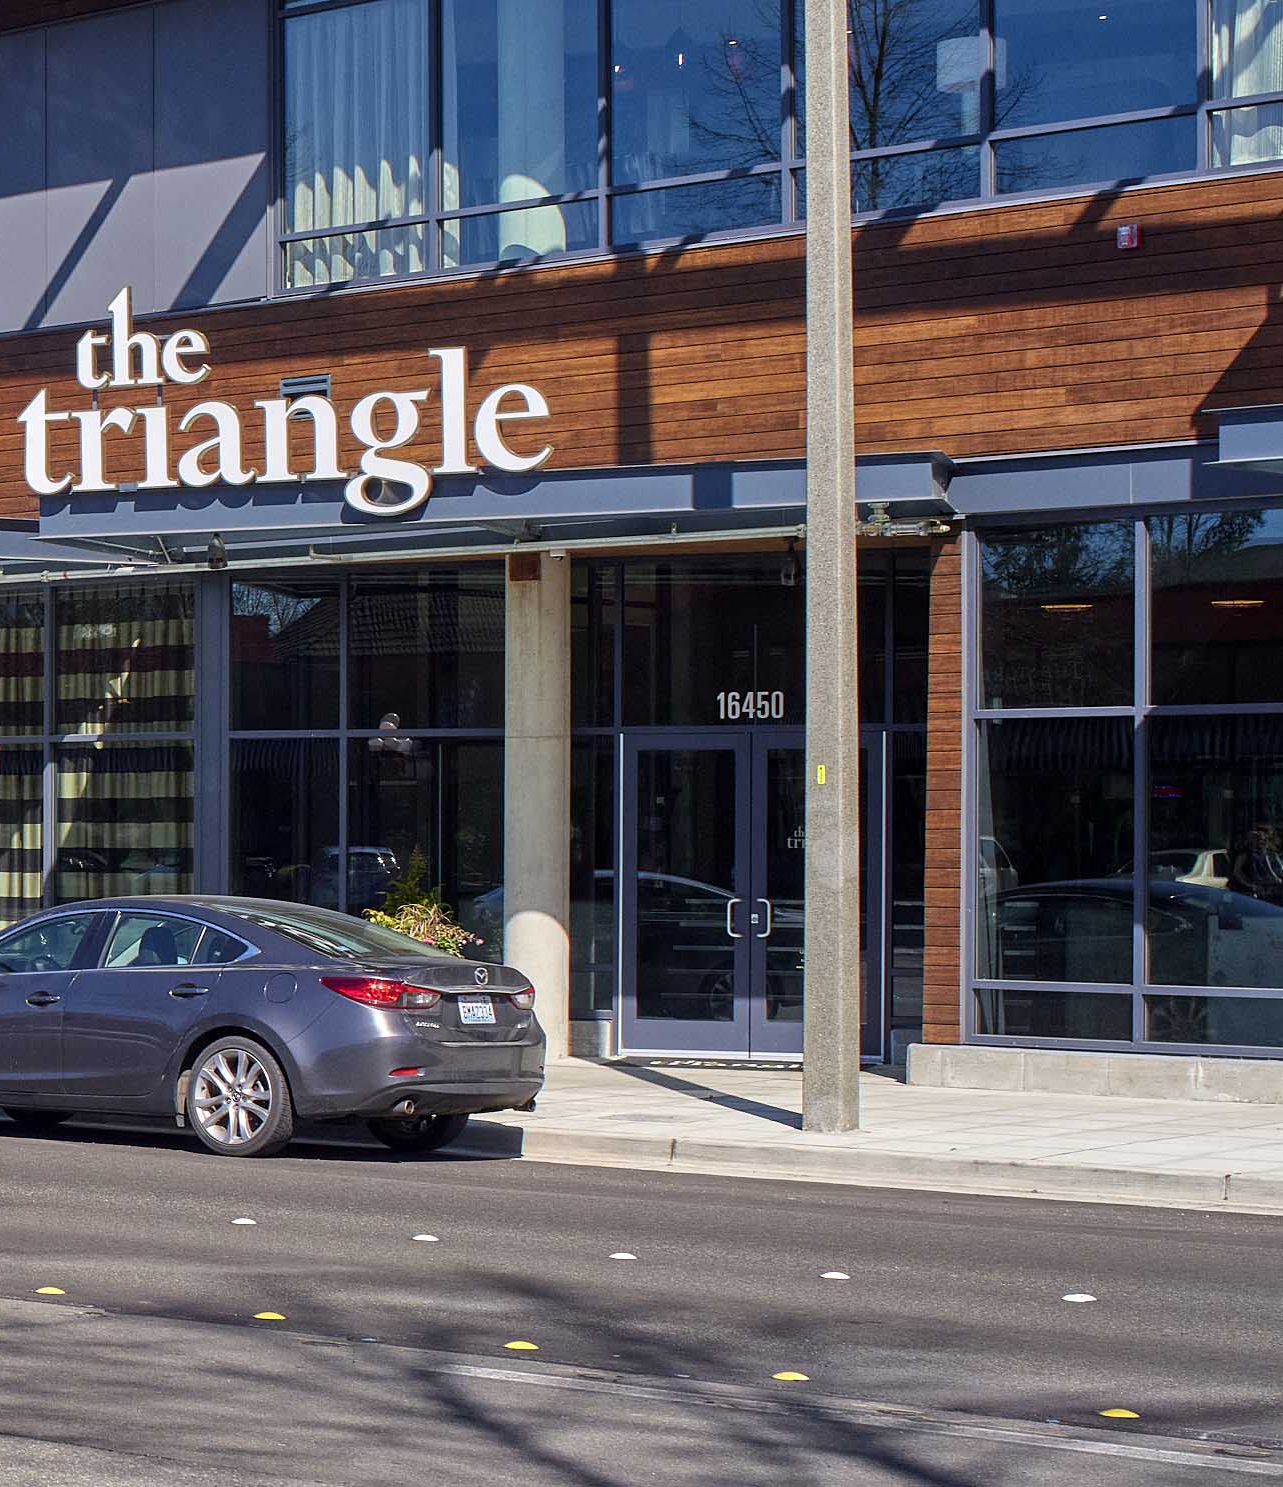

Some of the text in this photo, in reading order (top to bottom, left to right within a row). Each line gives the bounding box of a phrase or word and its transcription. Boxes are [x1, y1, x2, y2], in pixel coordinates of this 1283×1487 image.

[76, 286, 211, 389] the
[18, 345, 554, 516] triangle
[716, 691, 784, 720] 16450
